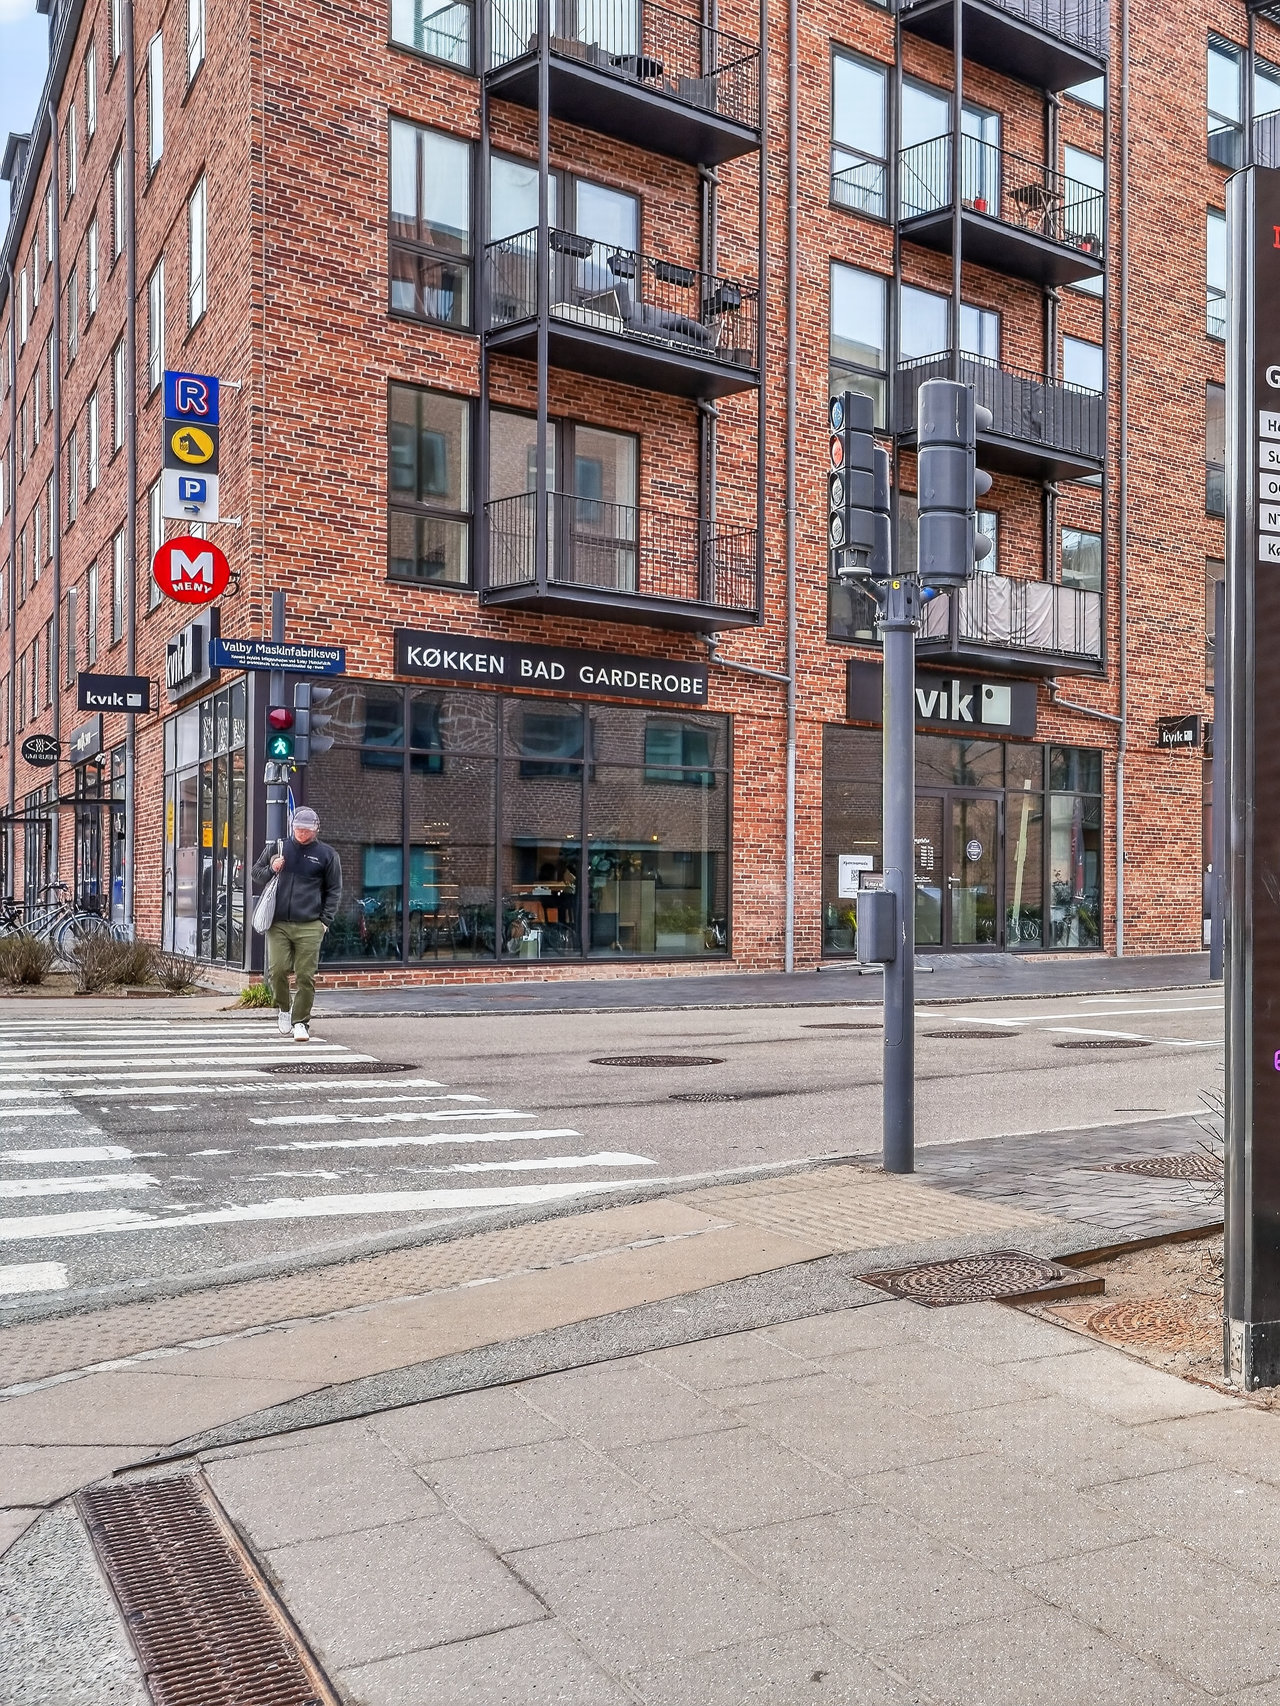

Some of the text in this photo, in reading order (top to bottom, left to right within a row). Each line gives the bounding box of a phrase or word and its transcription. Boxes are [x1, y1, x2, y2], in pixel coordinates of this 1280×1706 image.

[175, 377, 209, 416] R
[185, 480, 200, 498] P
[170, 549, 214, 583] M
[172, 582, 212, 595] MENY
[222, 641, 252, 653] Valby
[255, 644, 340, 661] Maskinfabriksvej
[407, 645, 703, 695] KØKKEN BAD GARDEROBE
[86, 691, 124, 706] kvik
[916, 680, 974, 722] vik
